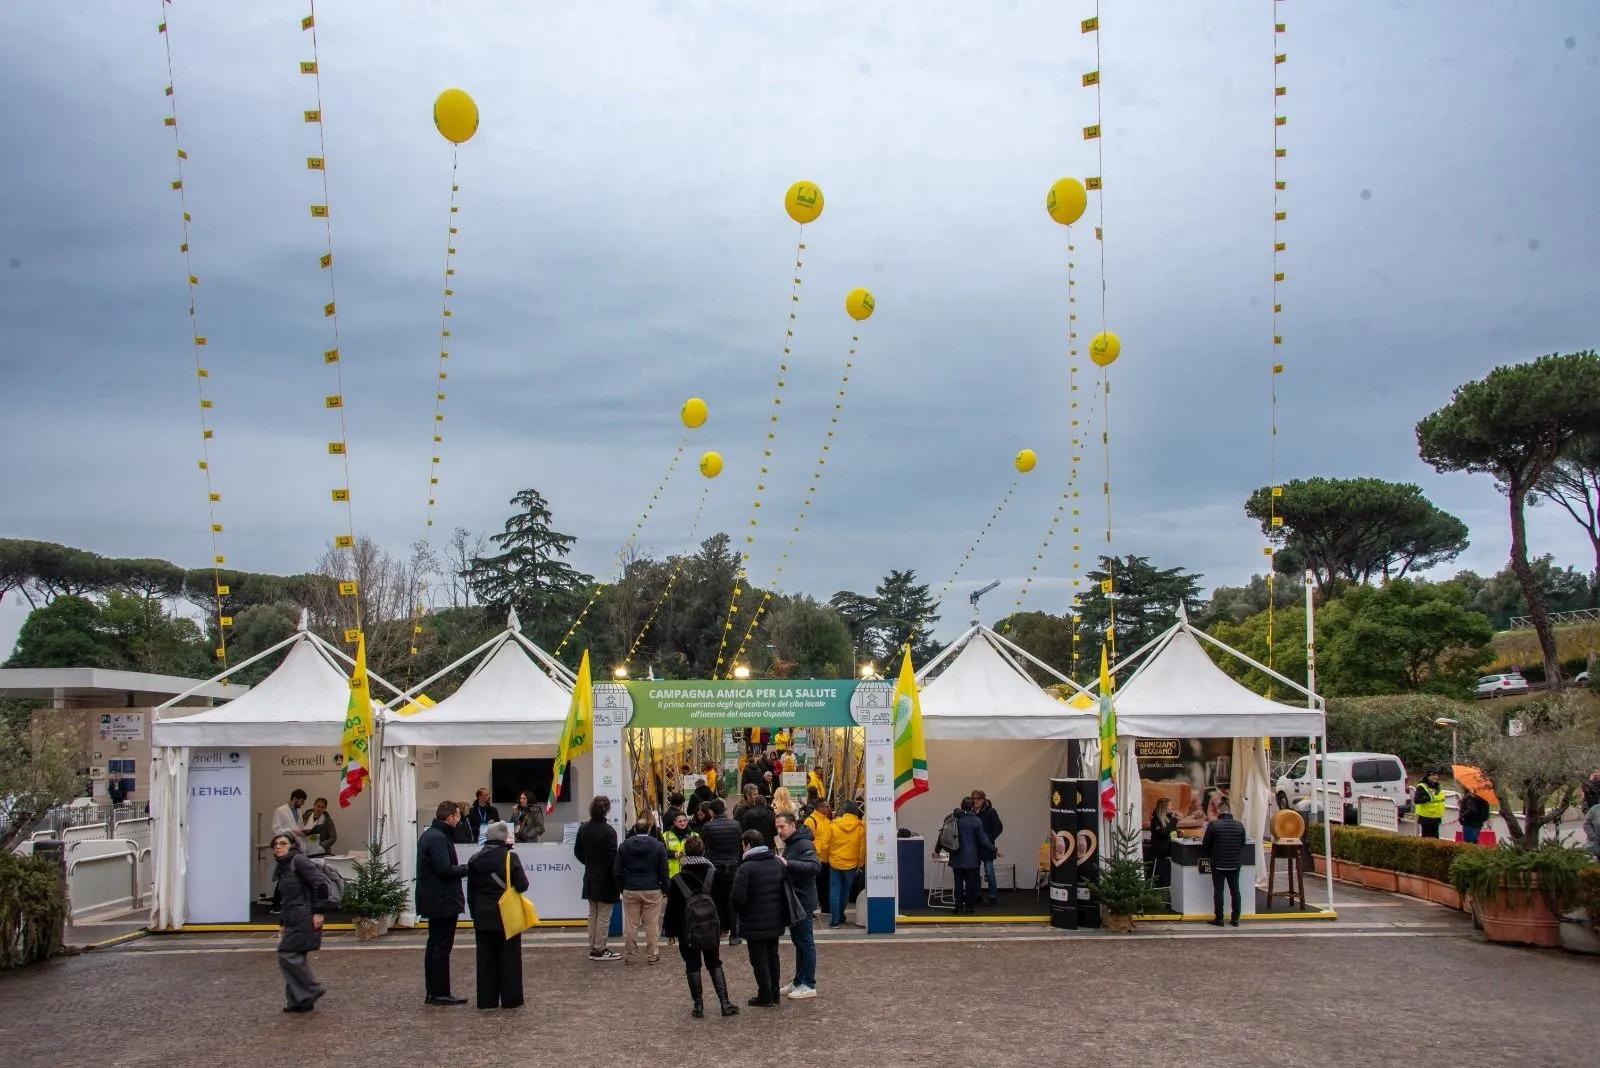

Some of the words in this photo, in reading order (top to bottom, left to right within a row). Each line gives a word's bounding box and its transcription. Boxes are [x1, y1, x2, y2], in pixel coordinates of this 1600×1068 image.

[649, 689, 714, 699] CAMPAGNA
[716, 689, 754, 698] AMICA
[756, 689, 776, 698] PER
[779, 689, 793, 698] LA
[795, 688, 837, 698] SALUTE
[664, 702, 685, 710] primo
[716, 701, 733, 710] degli
[734, 701, 770, 709] agricoltori
[789, 700, 804, 708] cibo
[762, 710, 796, 719] Ospedale
[1135, 741, 1177, 749] PARMIGIANO
[191, 752, 222, 763] emelli
[281, 753, 325, 766] Gemelli
[187, 786, 242, 796] LETHEIA
[524, 863, 572, 872] ALETHEIA
